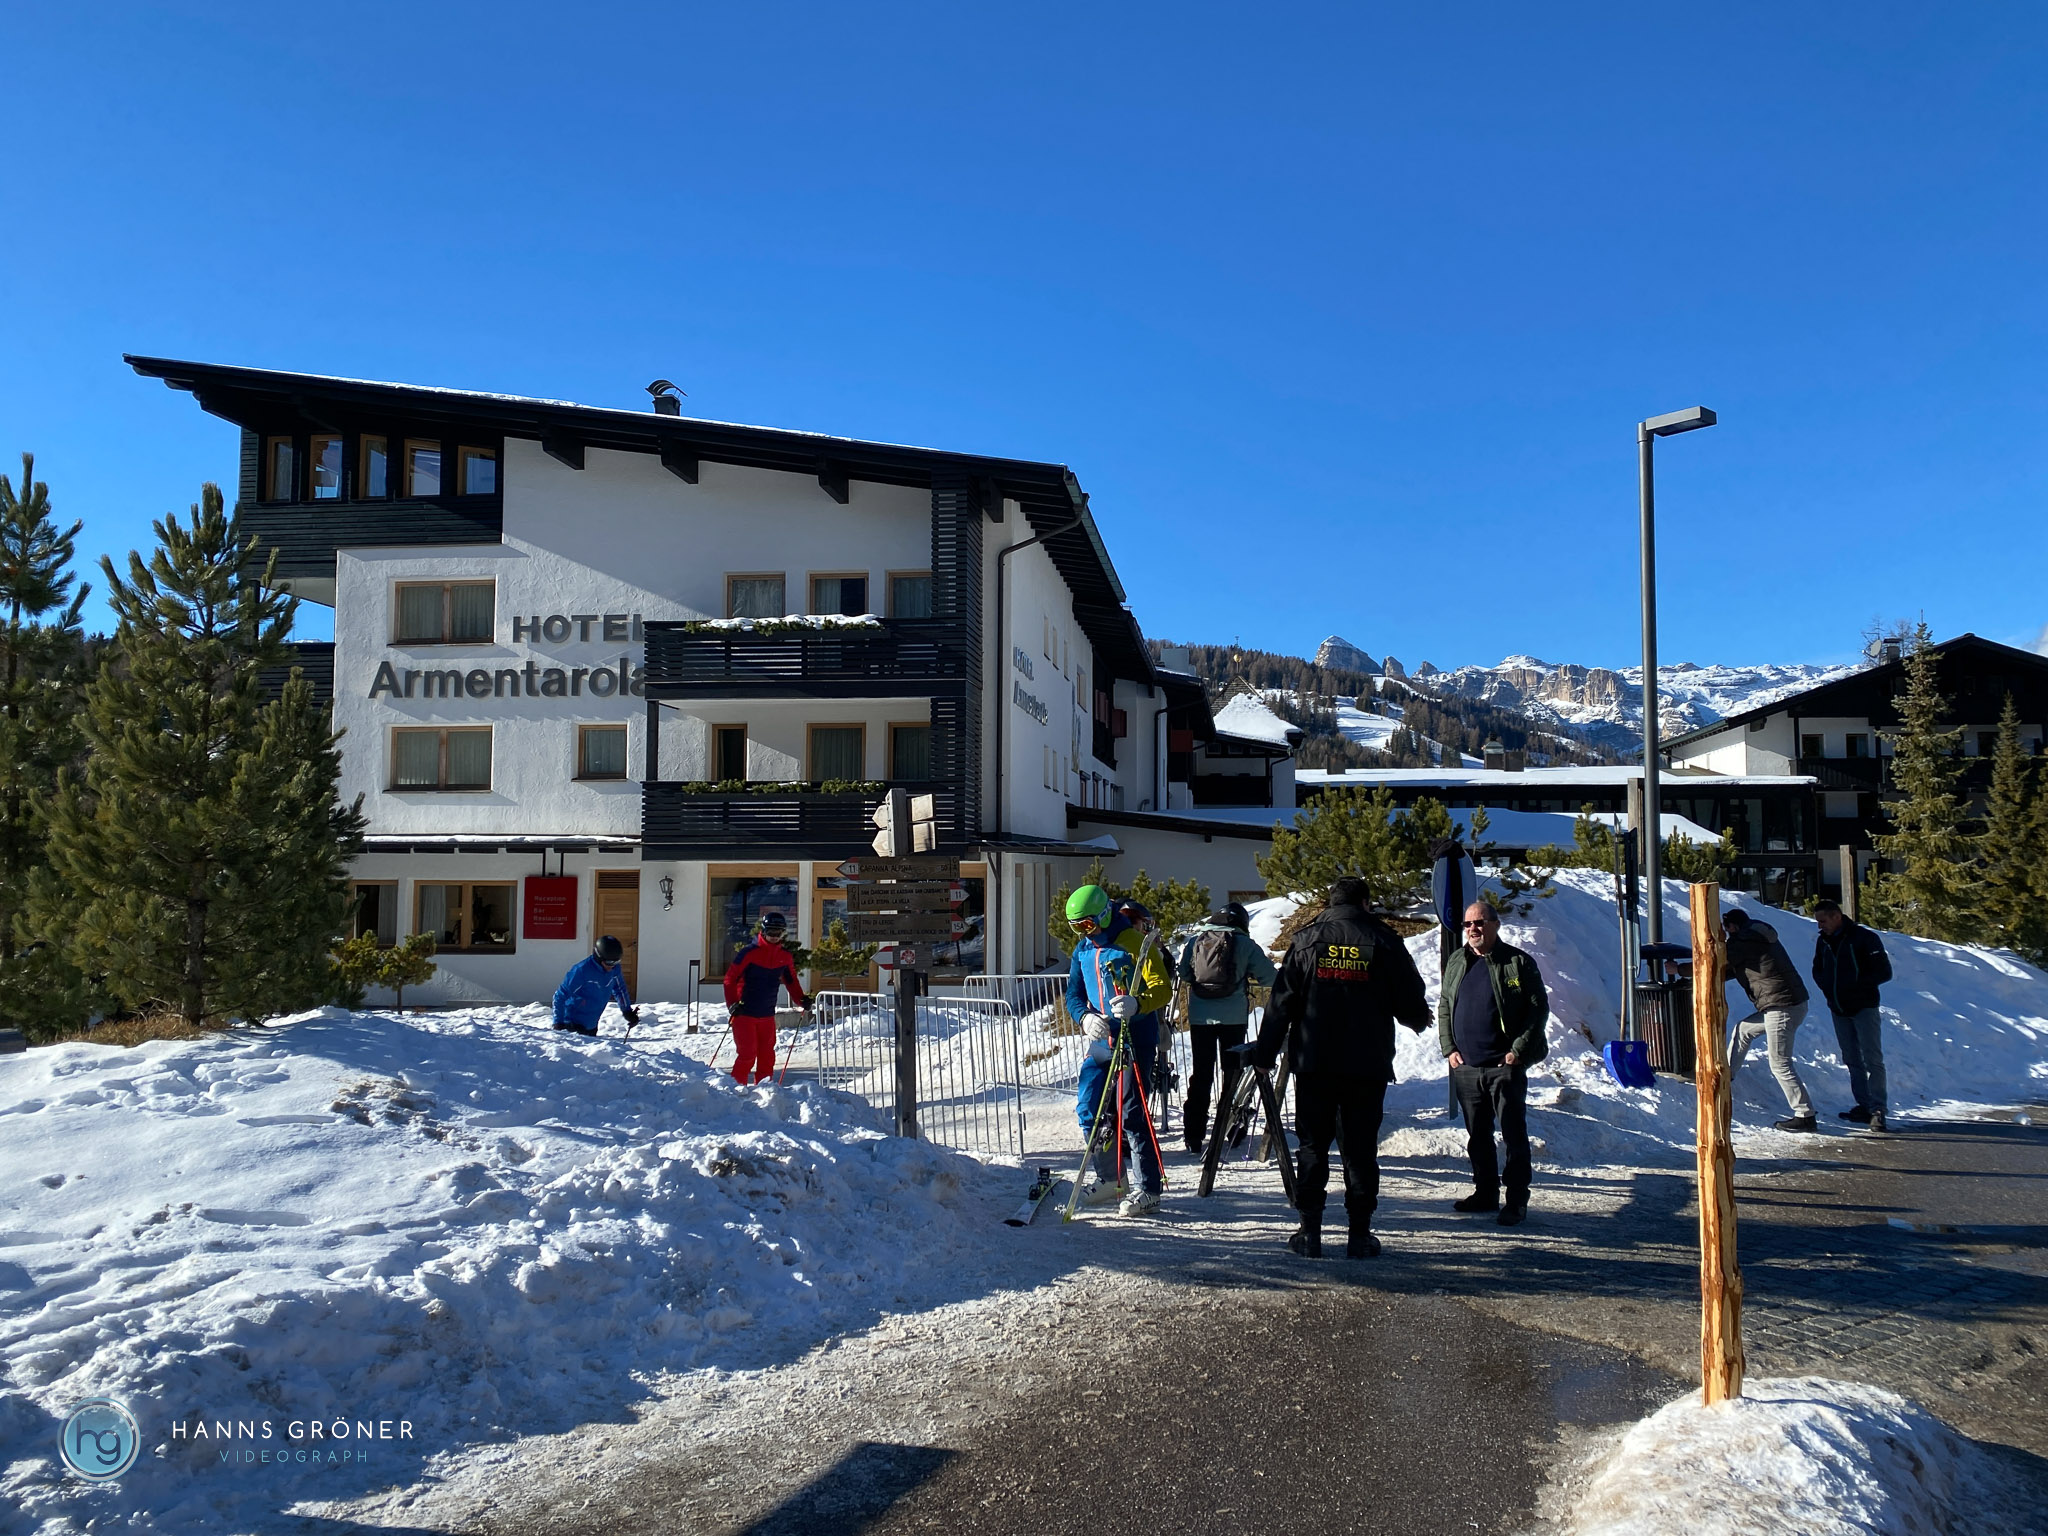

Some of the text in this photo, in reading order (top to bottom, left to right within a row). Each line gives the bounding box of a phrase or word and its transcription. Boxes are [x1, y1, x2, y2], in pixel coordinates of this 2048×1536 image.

[512, 613, 645, 643] HOTEL
[367, 657, 645, 699] Armentarola
[848, 864, 857, 874] 11
[860, 864, 889, 873] CAPANNA
[955, 891, 962, 899] 11
[953, 923, 965, 931] 15A
[1328, 945, 1360, 959] STS
[1318, 958, 1369, 971] SECURITY
